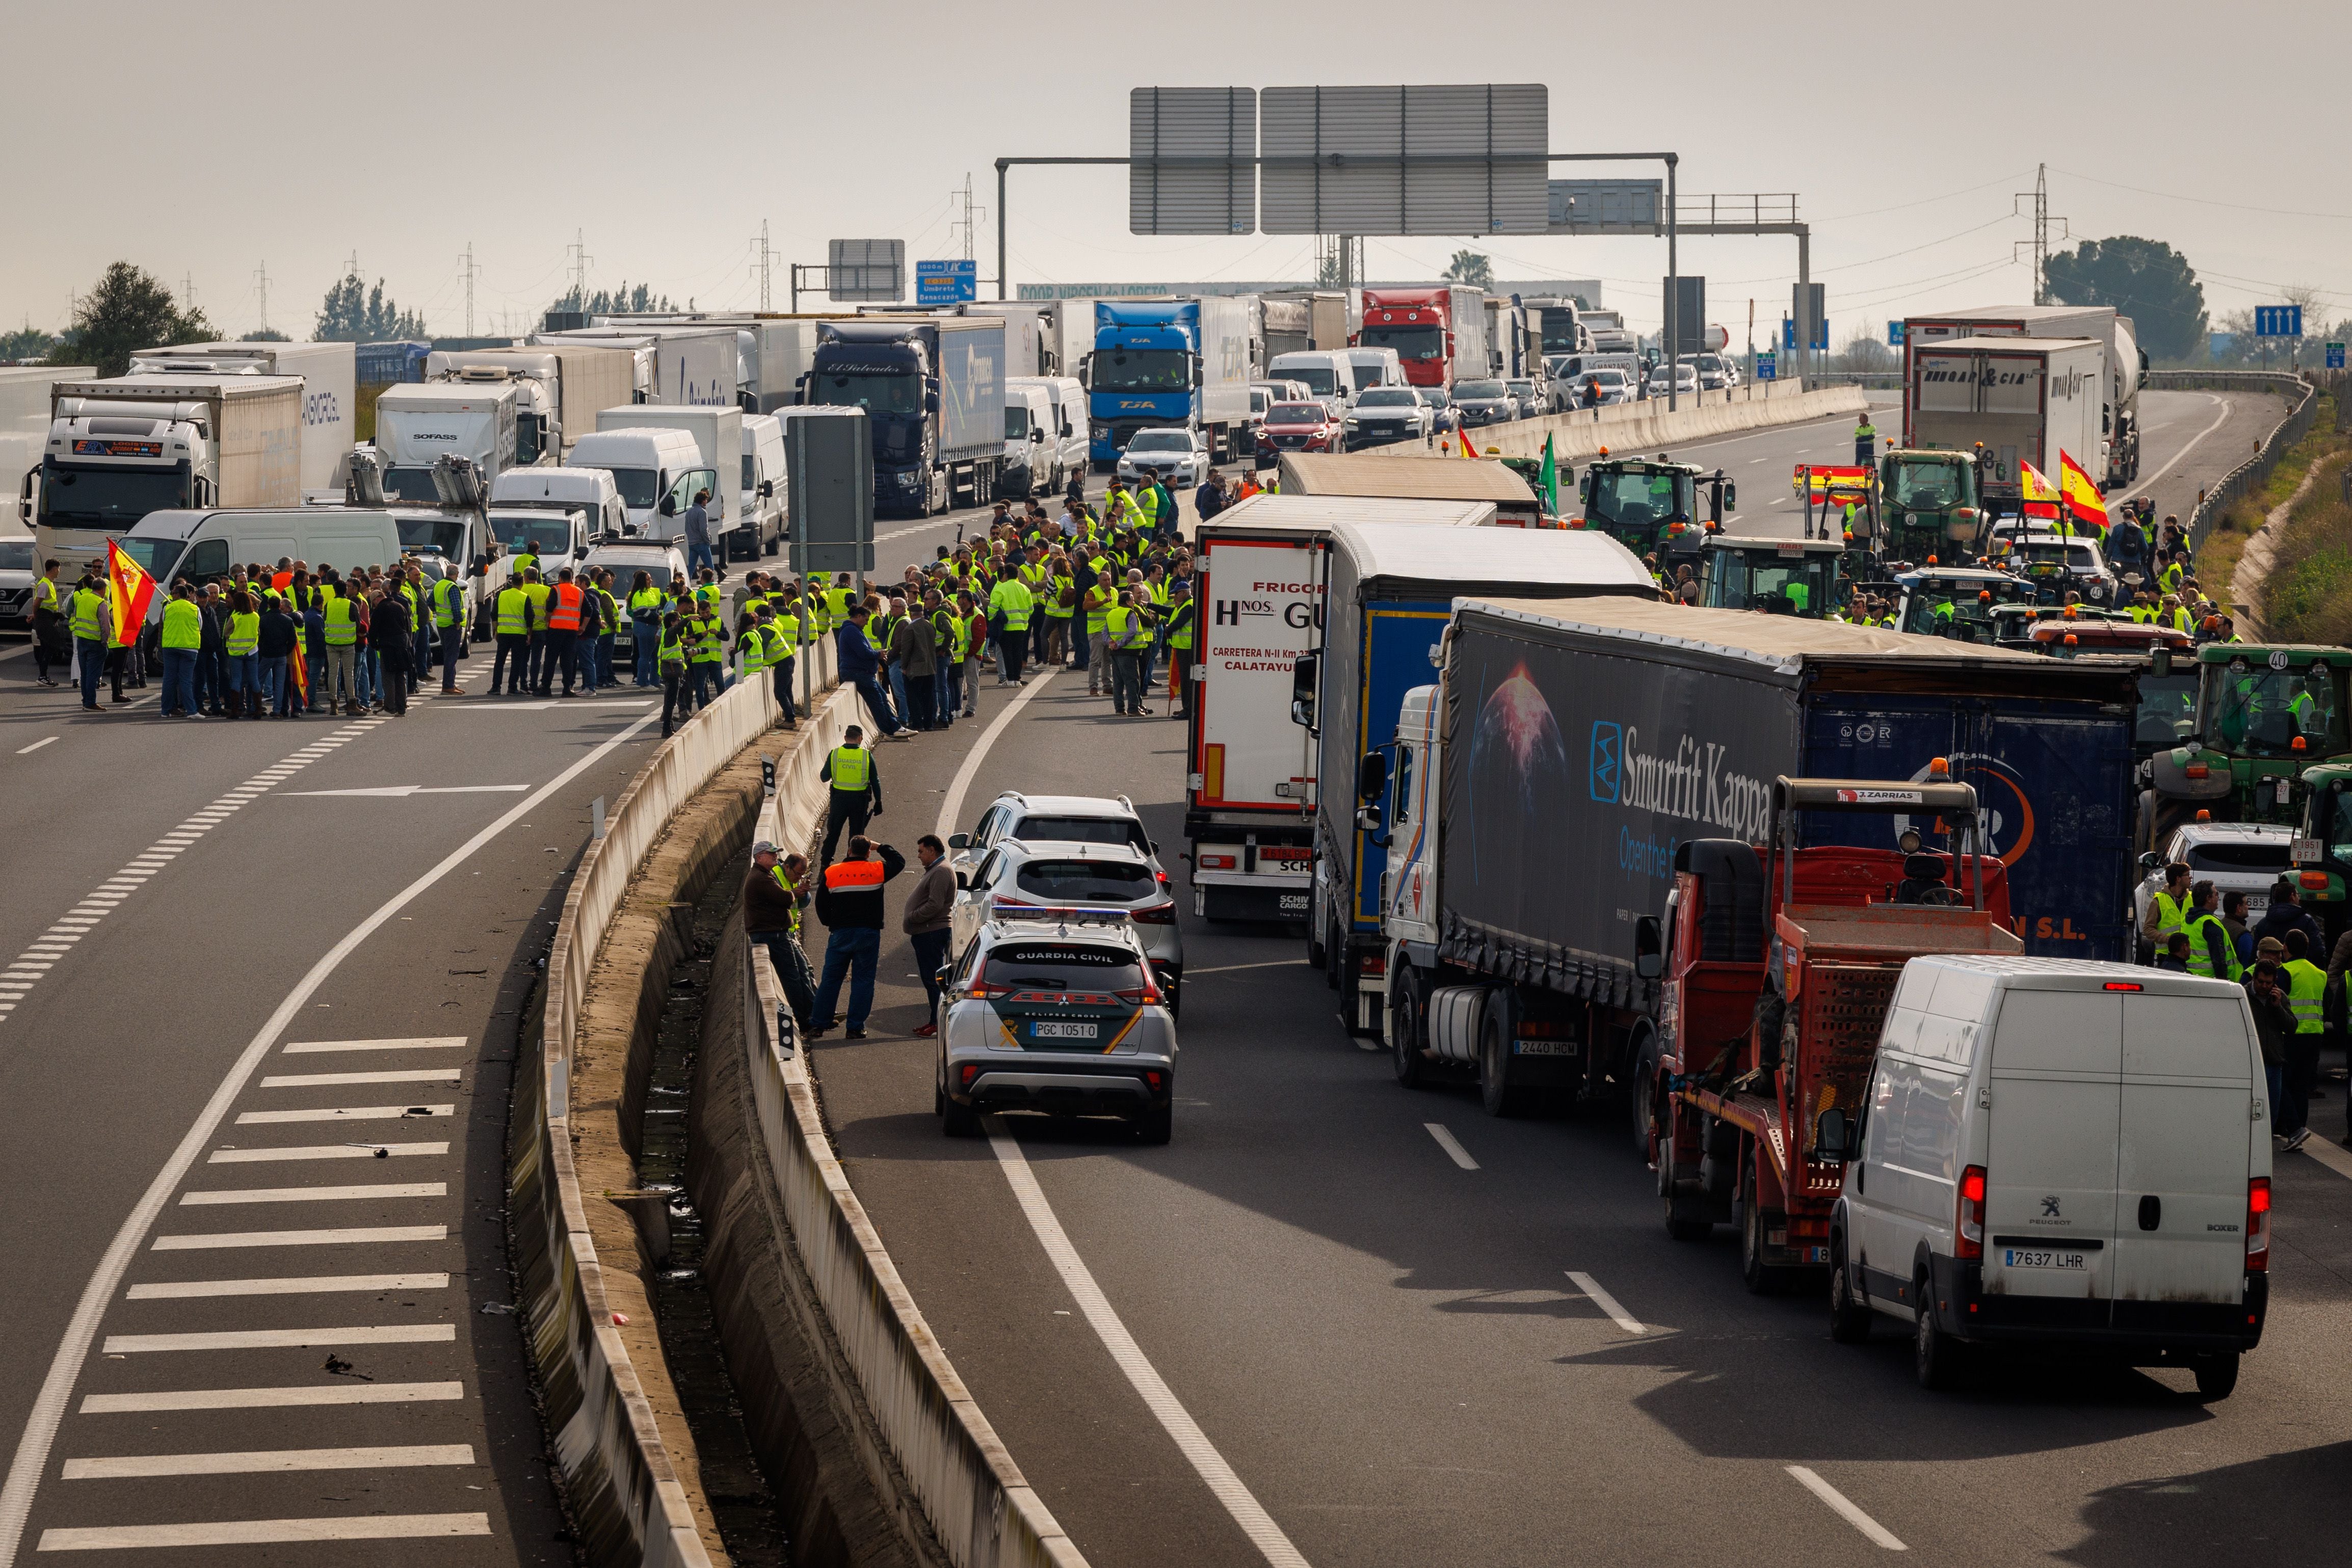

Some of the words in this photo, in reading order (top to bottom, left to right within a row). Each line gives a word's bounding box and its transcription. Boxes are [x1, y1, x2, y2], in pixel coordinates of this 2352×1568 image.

[1059, 285, 1101, 300] VIRGEN
[1122, 285, 1167, 297] LORETO
[828, 363, 841, 372] El
[842, 363, 900, 373] Salvador
[1120, 401, 1156, 409] TJA
[1908, 514, 1916, 525] 40
[2091, 588, 2102, 598] 40
[1213, 647, 1262, 657] CARRETERA
[1264, 649, 1280, 658] N-II
[1283, 649, 1297, 658] Km
[2271, 653, 2286, 667] 40
[1225, 661, 1296, 672] CALATAYU
[1623, 726, 1702, 821] Smurfit
[1702, 742, 1770, 843] Kappa
[2293, 841, 2298, 849] E
[2301, 841, 2319, 850] 1951
[1620, 825, 1646, 882] Open
[1648, 833, 1666, 880] the
[2297, 851, 2316, 860] BFP
[1617, 908, 1629, 921] PAPER
[2036, 916, 2087, 941] S.L.
[1080, 953, 1113, 963] CIVIL
[779, 1003, 785, 1013] 3
[1037, 1024, 1056, 1035] PGC
[1522, 1042, 1549, 1053] 2440
[2207, 1224, 2239, 1233] BOXER
[1820, 1248, 1829, 1261] 8
[2015, 1252, 2052, 1266] 7637
[2056, 1254, 2083, 1269] LHR
